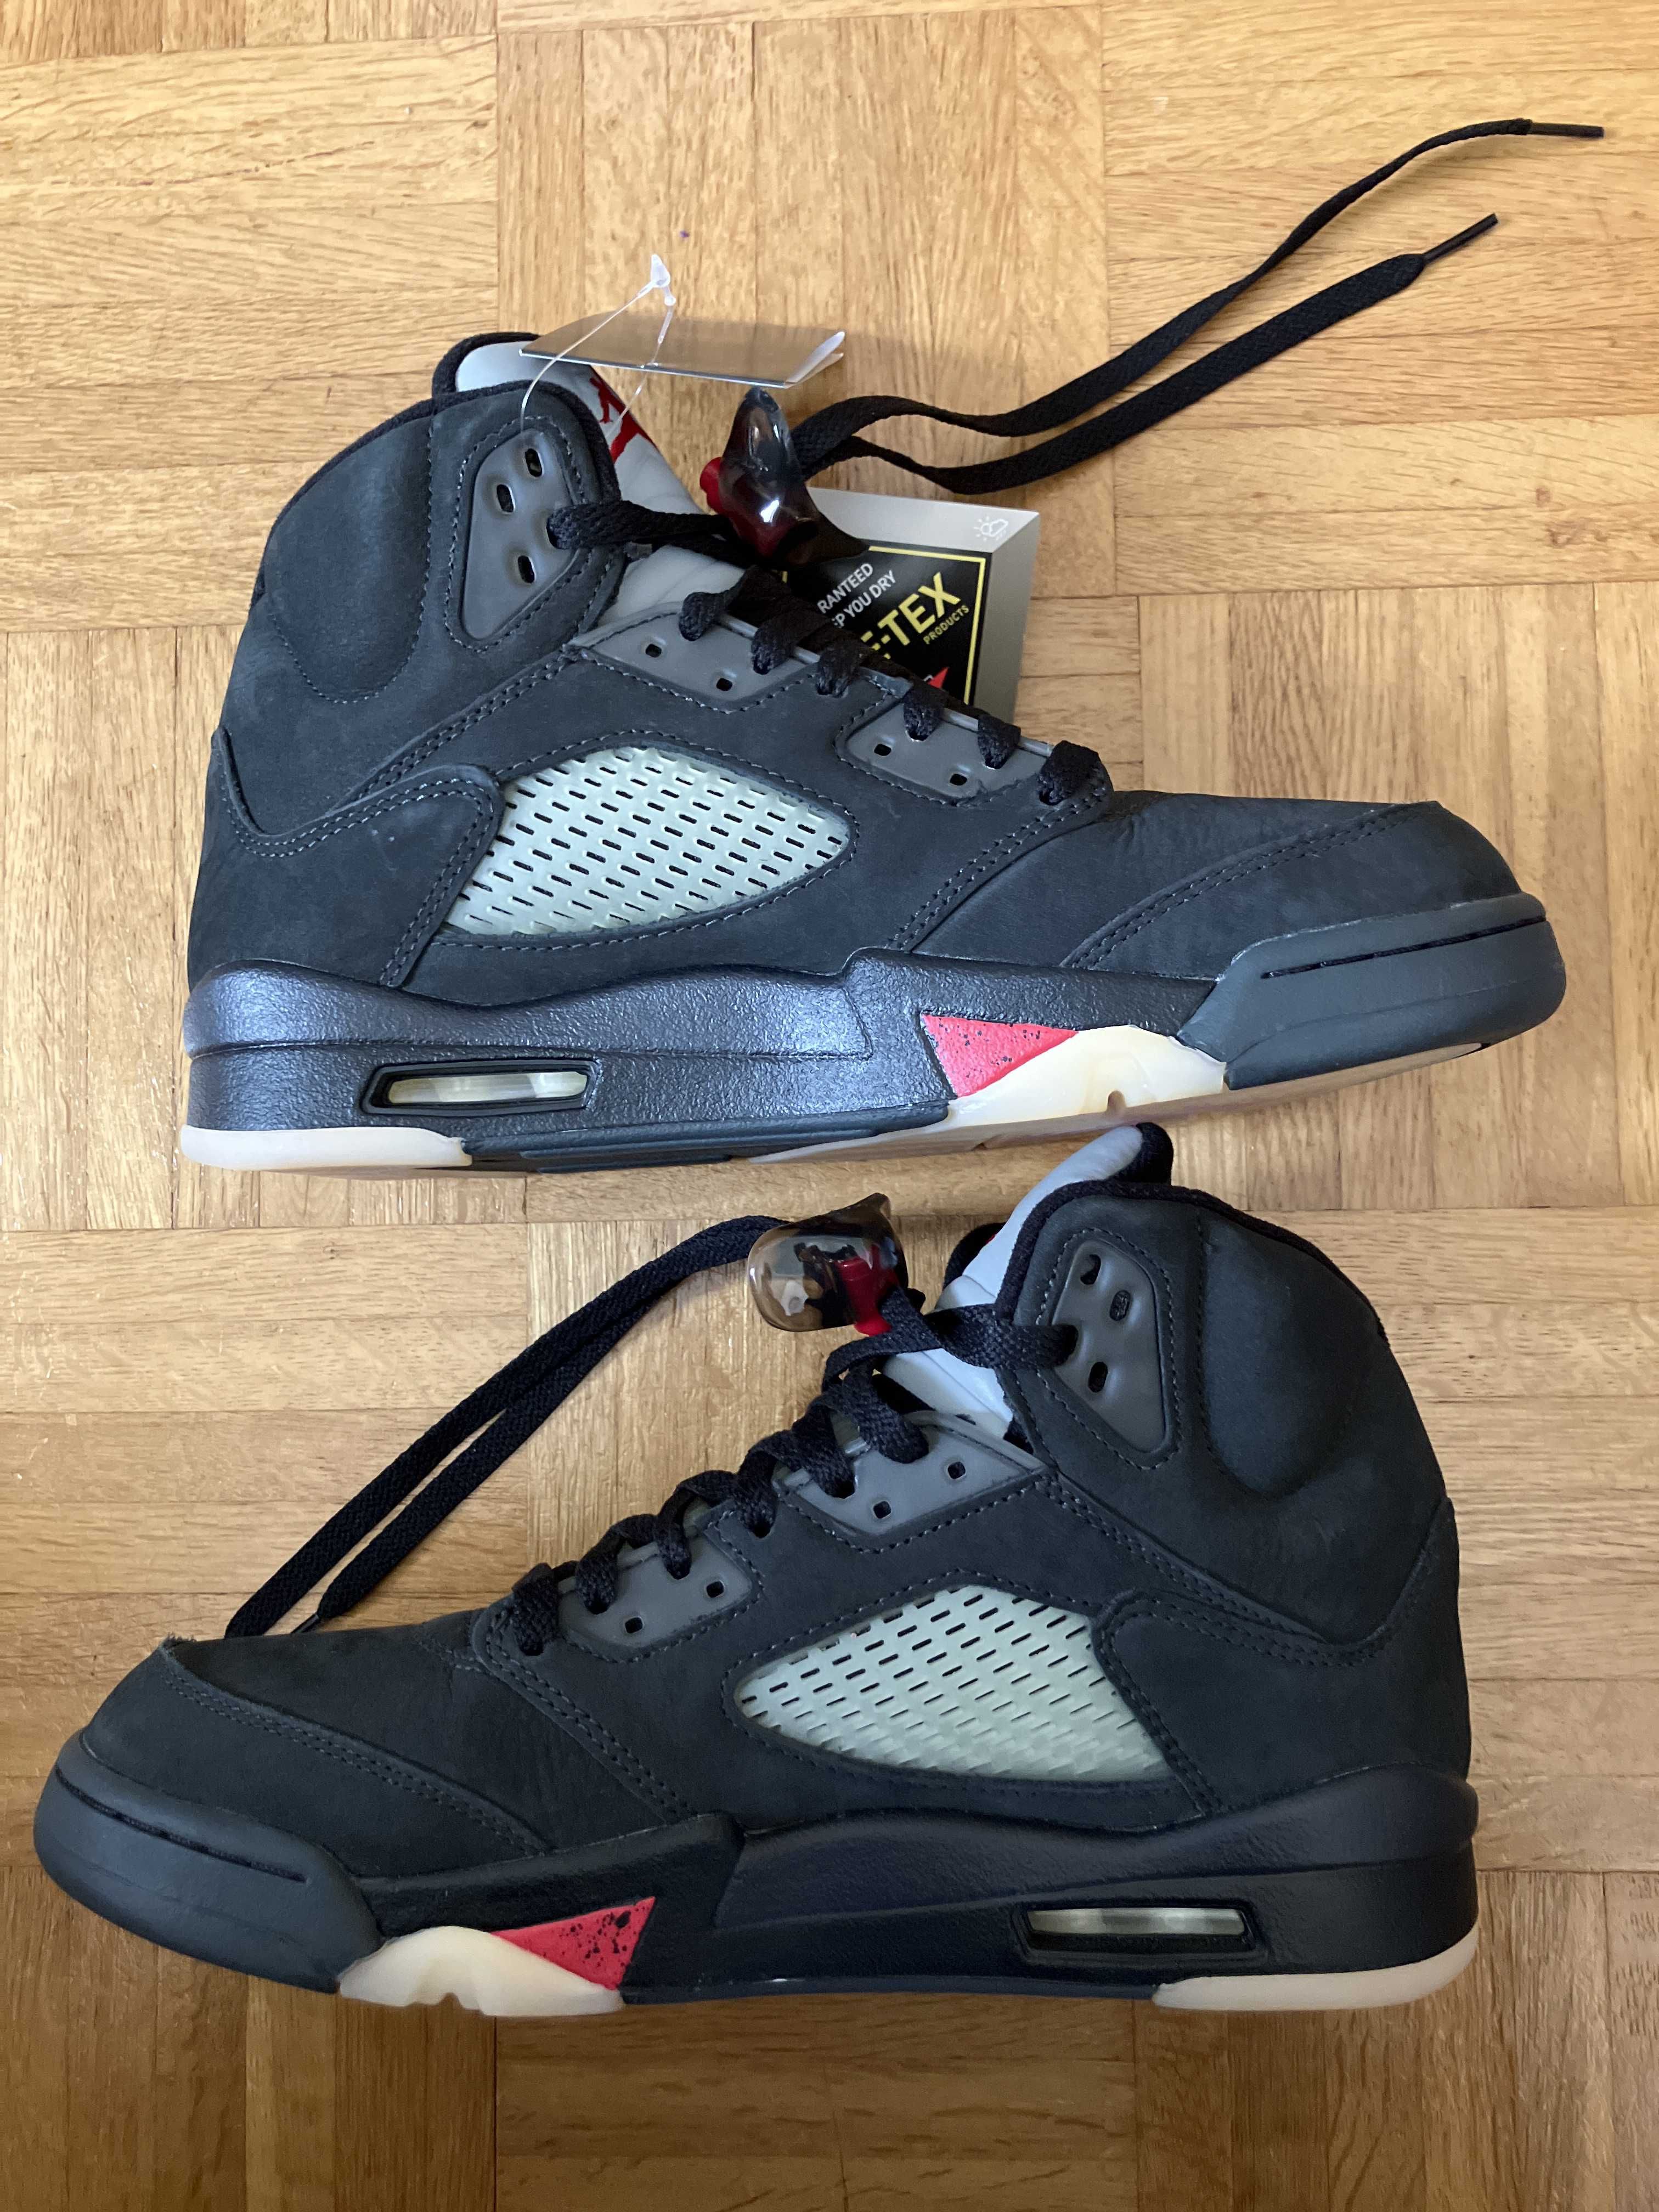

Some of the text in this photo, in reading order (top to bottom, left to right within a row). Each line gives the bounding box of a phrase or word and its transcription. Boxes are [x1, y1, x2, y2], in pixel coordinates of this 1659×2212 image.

[817, 563, 873, 614] RANTEED
[843, 592, 872, 618] YOU
[868, 569, 896, 599] DRY
[923, 605, 970, 645] PRODUCTS
